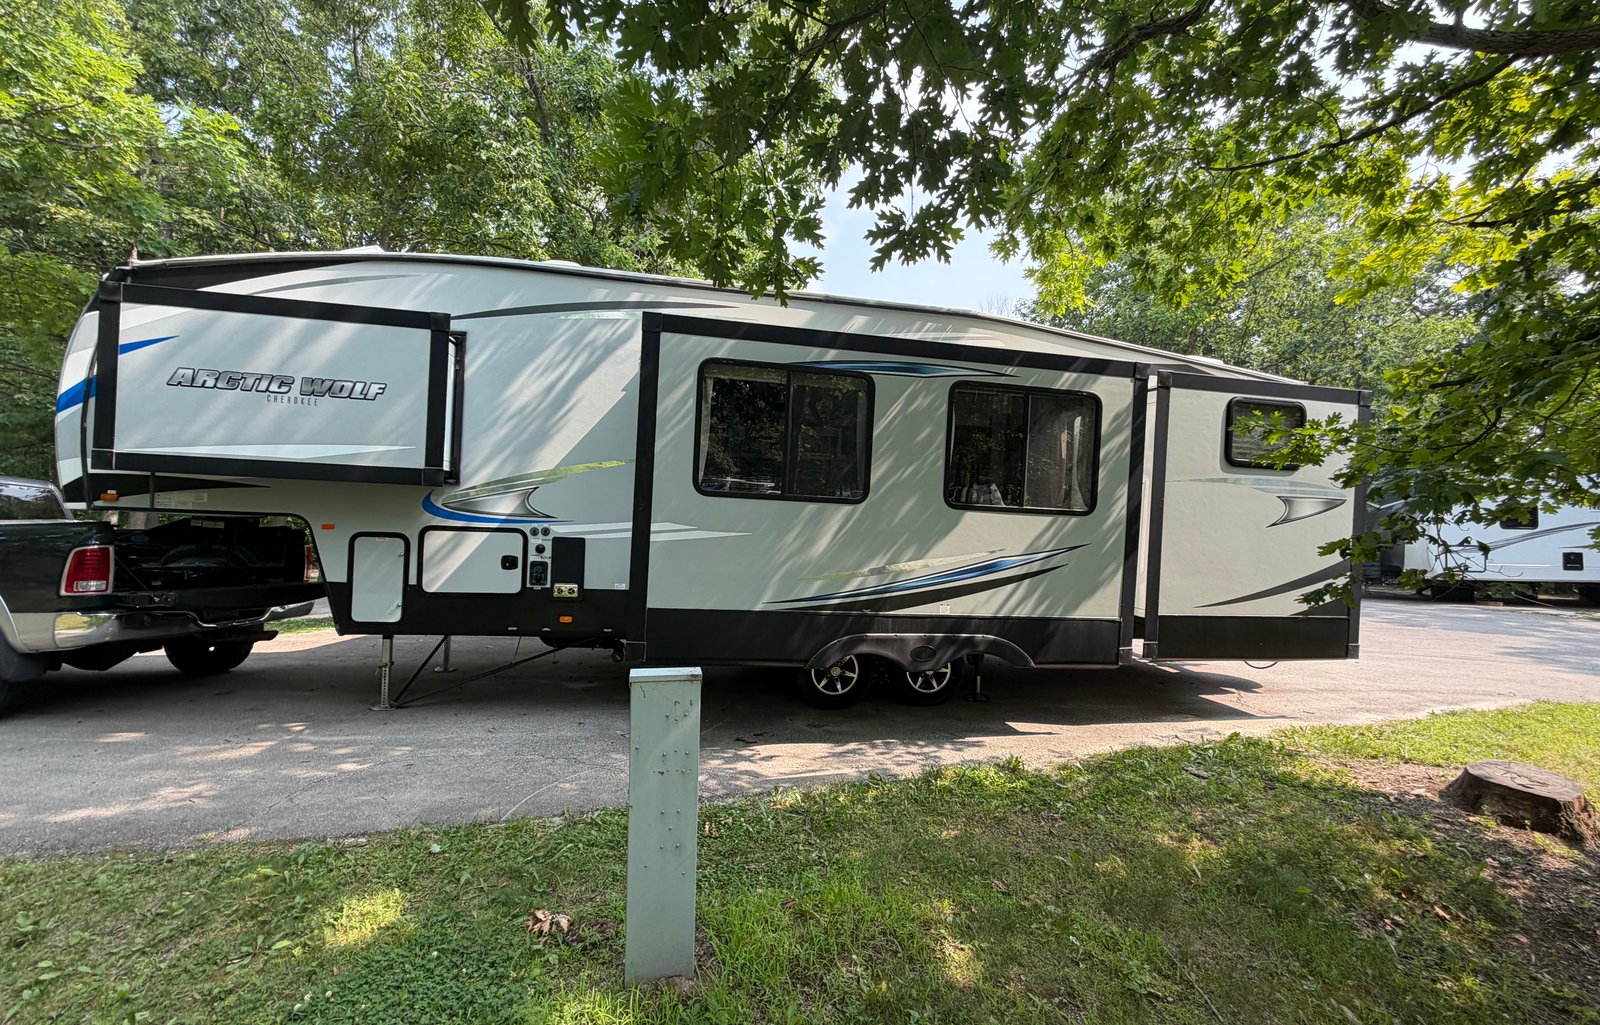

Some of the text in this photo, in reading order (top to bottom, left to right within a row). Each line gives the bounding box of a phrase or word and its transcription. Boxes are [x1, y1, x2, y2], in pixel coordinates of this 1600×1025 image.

[167, 367, 387, 400] ARCTIC WOLF
[267, 395, 318, 406] CHEROKEE
